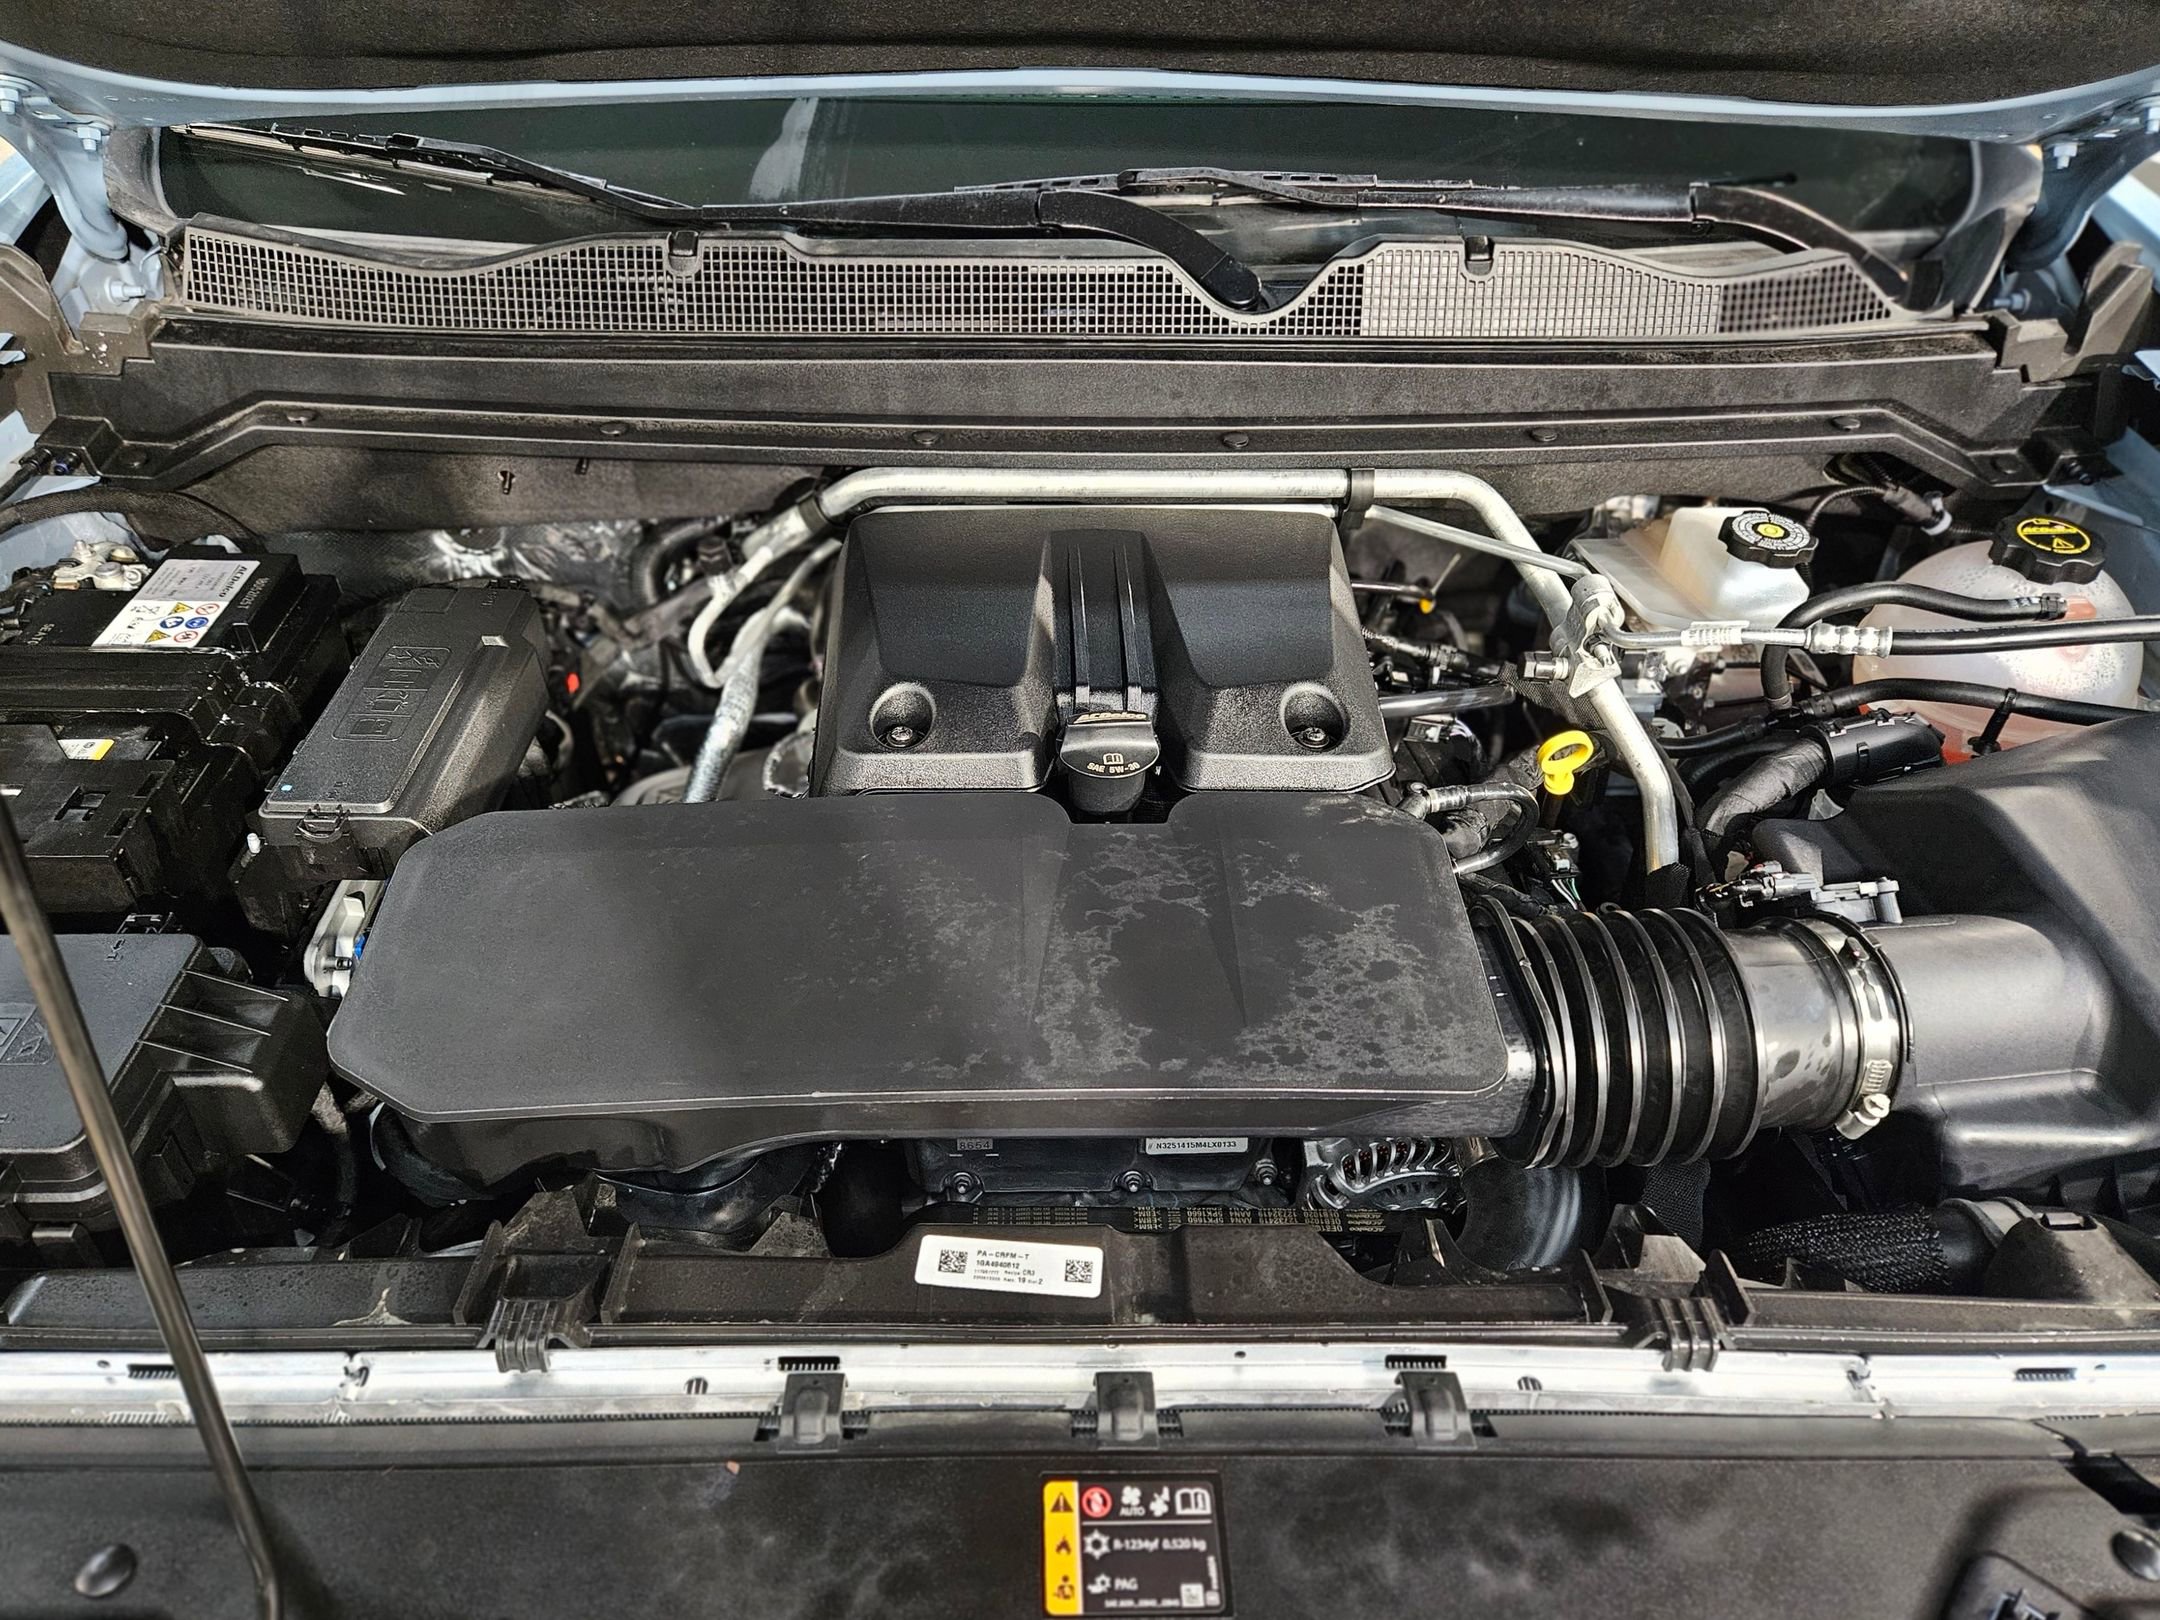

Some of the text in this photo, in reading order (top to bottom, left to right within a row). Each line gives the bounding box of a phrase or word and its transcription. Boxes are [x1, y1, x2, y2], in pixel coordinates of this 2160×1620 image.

[217, 565, 248, 598] ACDelco
[1073, 711, 1148, 724] ACDelco
[1086, 762, 1106, 773] SAE
[1109, 762, 1141, 773] 5W-30
[959, 1141, 991, 1150] 8654
[1119, 1506, 1146, 1517] AUTO
[1192, 1537, 1207, 1551] kg
[1114, 1578, 1139, 1590] PAG
